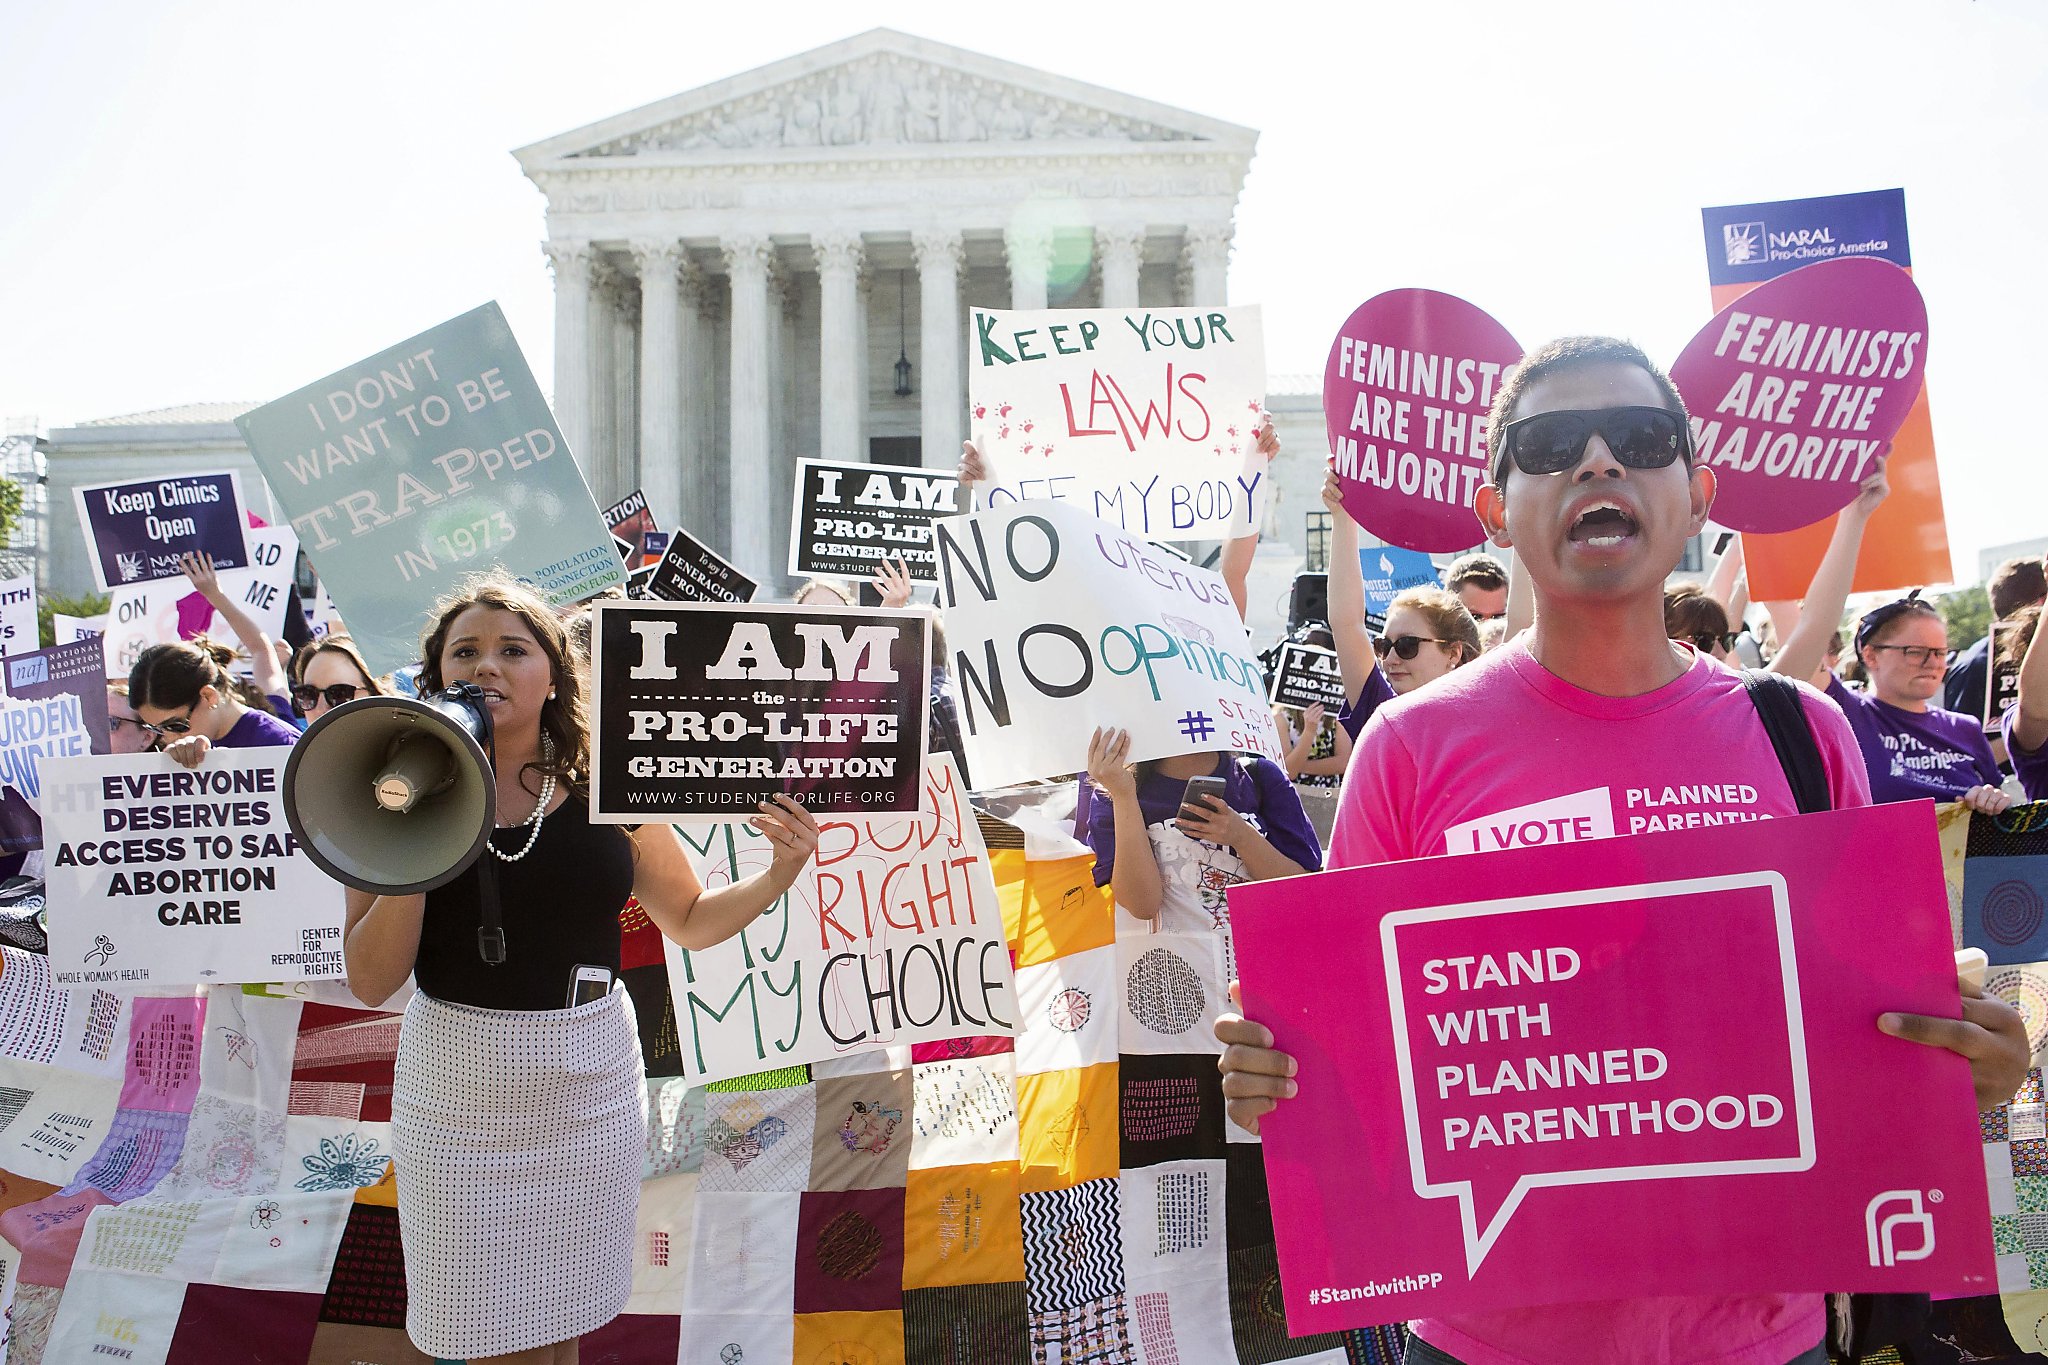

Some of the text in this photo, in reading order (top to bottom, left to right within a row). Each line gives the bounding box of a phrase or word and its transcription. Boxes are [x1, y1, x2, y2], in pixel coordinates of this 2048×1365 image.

[1769, 227, 1836, 248] NARAL
[1769, 239, 1889, 261] Pro-Choice America
[975, 312, 1235, 366] KEEP YOUR
[1713, 311, 1922, 380] FEMINISTS
[308, 348, 440, 431] I DON'T
[1715, 372, 1884, 431] ARE THE
[1059, 362, 1211, 453] LAWS
[283, 367, 512, 487] WANT TO BE
[1350, 391, 1489, 460] ARE THE
[1689, 416, 1881, 483] MAJORITY
[1335, 435, 1489, 508] MAJORIT
[104, 479, 220, 516] Keep Clinics
[291, 427, 556, 552] TRAPPED
[815, 469, 960, 512] I AM
[1094, 475, 1159, 534] MY
[1171, 471, 1262, 529] BODY
[145, 516, 197, 544] Open
[812, 517, 933, 544] PRO-LIF
[877, 509, 895, 520] the
[393, 510, 517, 582] IN 1973
[535, 544, 609, 580] POPULATION
[811, 542, 936, 563] GENERATIO
[936, 515, 1060, 608] NO
[540, 556, 615, 592] CONNECTION
[589, 570, 620, 590] FUND
[721, 567, 729, 580] la
[0, 586, 31, 607] ITH
[49, 643, 100, 661] NATIONAL
[50, 653, 101, 671] ABORTION
[630, 620, 900, 683] I AM
[1289, 651, 1344, 678] I A
[50, 662, 102, 681] FEDERATION
[956, 623, 1094, 736] NO
[1285, 674, 1345, 696] PRO-LIF
[752, 691, 785, 706] the
[0, 698, 79, 748] URDEN
[627, 710, 899, 744] PRO-LIFE
[102, 767, 276, 801] EVERYONE
[627, 756, 897, 779] GENERATION
[1626, 784, 1759, 809] PLANNED
[103, 801, 271, 833] DESERVES
[1472, 816, 1595, 852] I VOTE
[1629, 811, 1775, 835] PARENTH
[54, 832, 302, 867] ACCESS TO SAF
[107, 866, 276, 897] ABORTION
[157, 900, 242, 927] CARE
[817, 856, 979, 950] RIGHT
[302, 927, 340, 941] CENTER
[302, 940, 322, 952] FOR
[56, 968, 149, 984] WHOLE WOMAN'S HEALTH
[271, 951, 342, 966] REPRODUCTIVE
[304, 962, 343, 976] RIGHTS
[1422, 947, 1581, 995] STAND
[687, 961, 801, 1074] MY
[819, 936, 1014, 1046] CHOICE
[1427, 1002, 1552, 1047] WITH
[1436, 1047, 1669, 1100] PLANNED
[1443, 1093, 1785, 1152] PARENTHOOD
[1308, 1271, 1444, 1307] #StandwithPP
